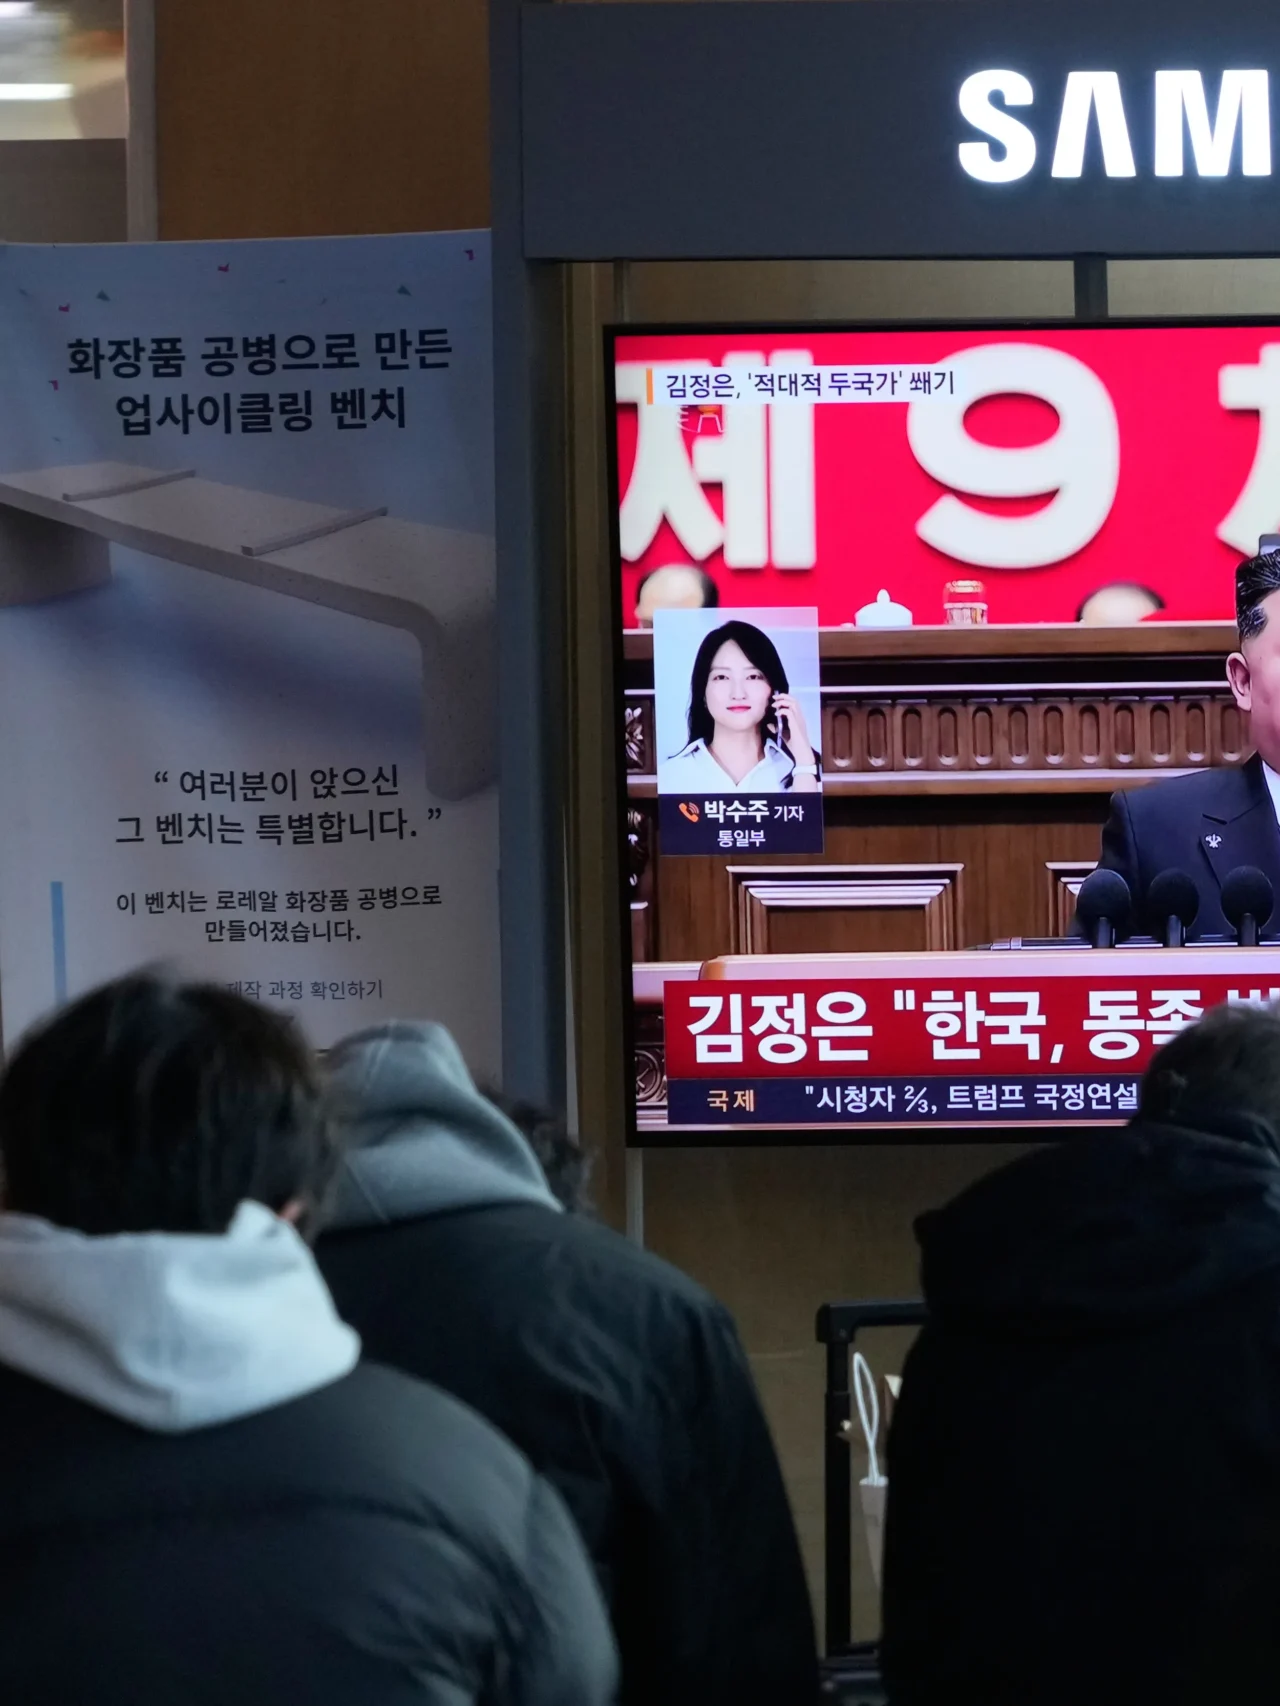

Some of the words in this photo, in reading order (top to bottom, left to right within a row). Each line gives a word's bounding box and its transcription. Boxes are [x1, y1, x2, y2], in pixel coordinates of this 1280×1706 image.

[67, 337, 186, 379] 화장품
[201, 333, 360, 377] 공병으로
[374, 328, 452, 371] 만든
[665, 373, 741, 399] 김정은,
[909, 370, 955, 395] 쐐기
[115, 391, 313, 436] 업사이클링
[330, 386, 407, 431] 벤치
[309, 764, 400, 800] 앉으신
[704, 800, 770, 823] 박수주
[773, 805, 805, 822] 기자
[115, 816, 145, 843] 그
[155, 812, 246, 846] 벤치는
[717, 829, 766, 848] 통일부
[116, 892, 137, 916] 이
[145, 889, 208, 914] 벤치는
[215, 889, 279, 913] 로레알
[285, 888, 350, 913] 화장품
[357, 885, 443, 911] 공병으로
[205, 918, 362, 944] 만들어졌습니다.
[268, 980, 304, 1000] 과정
[310, 979, 384, 1000] 확인하기
[686, 990, 874, 1065] 김정은
[894, 989, 1065, 1064] "한국,
[805, 1084, 897, 1113] "시청자
[947, 1083, 1026, 1111] 트럼프
[1034, 1082, 1138, 1111] 국정연설
